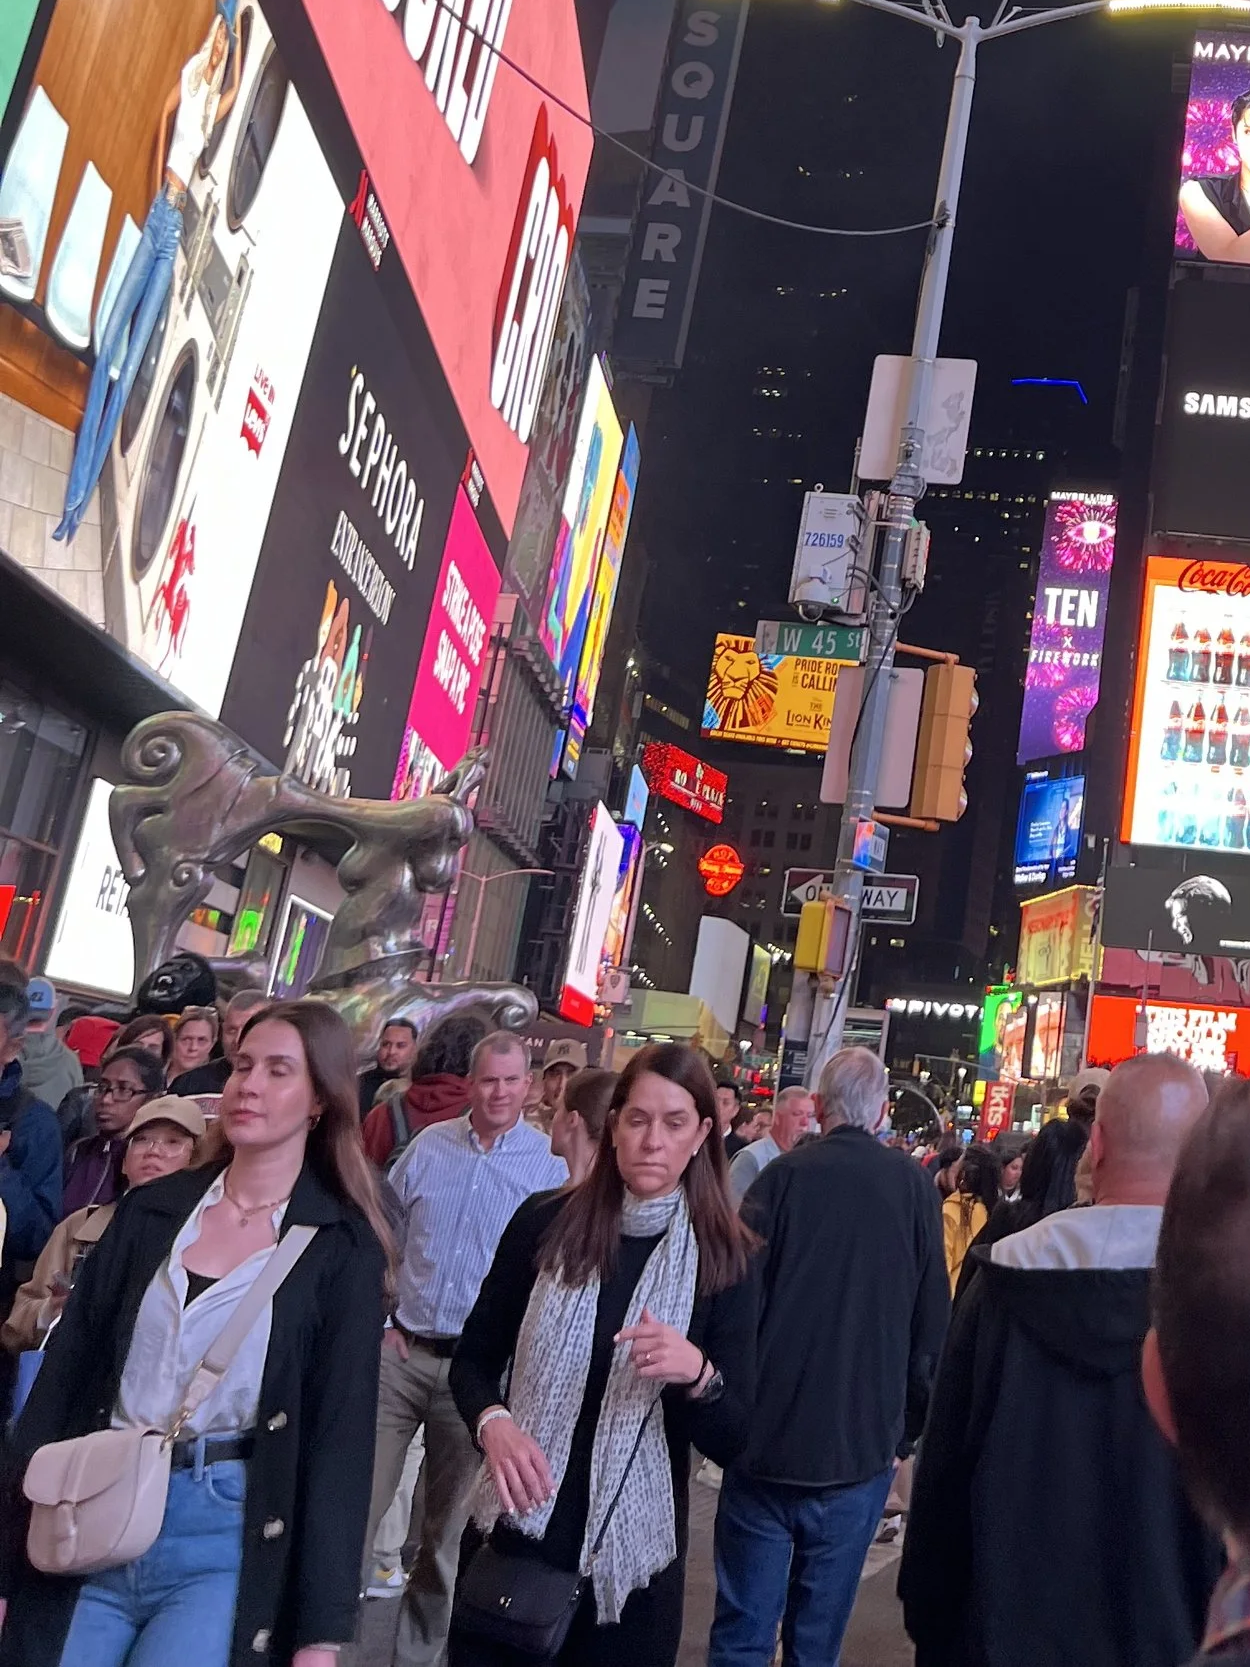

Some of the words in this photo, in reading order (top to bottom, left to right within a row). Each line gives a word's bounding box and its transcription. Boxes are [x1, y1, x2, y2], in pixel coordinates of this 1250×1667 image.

[632, 9, 720, 320] SQUARE
[338, 373, 424, 571] SEPHORA
[804, 532, 844, 548] 726159
[1044, 587, 1099, 627] TEN
[783, 628, 802, 652] W
[811, 629, 836, 655] 45
[846, 632, 860, 648] St
[794, 658, 824, 674] PRIDE
[1030, 650, 1100, 667] FIREWORK
[786, 711, 811, 728] LION
[813, 713, 832, 731] KIN
[862, 889, 899, 909] WAY
